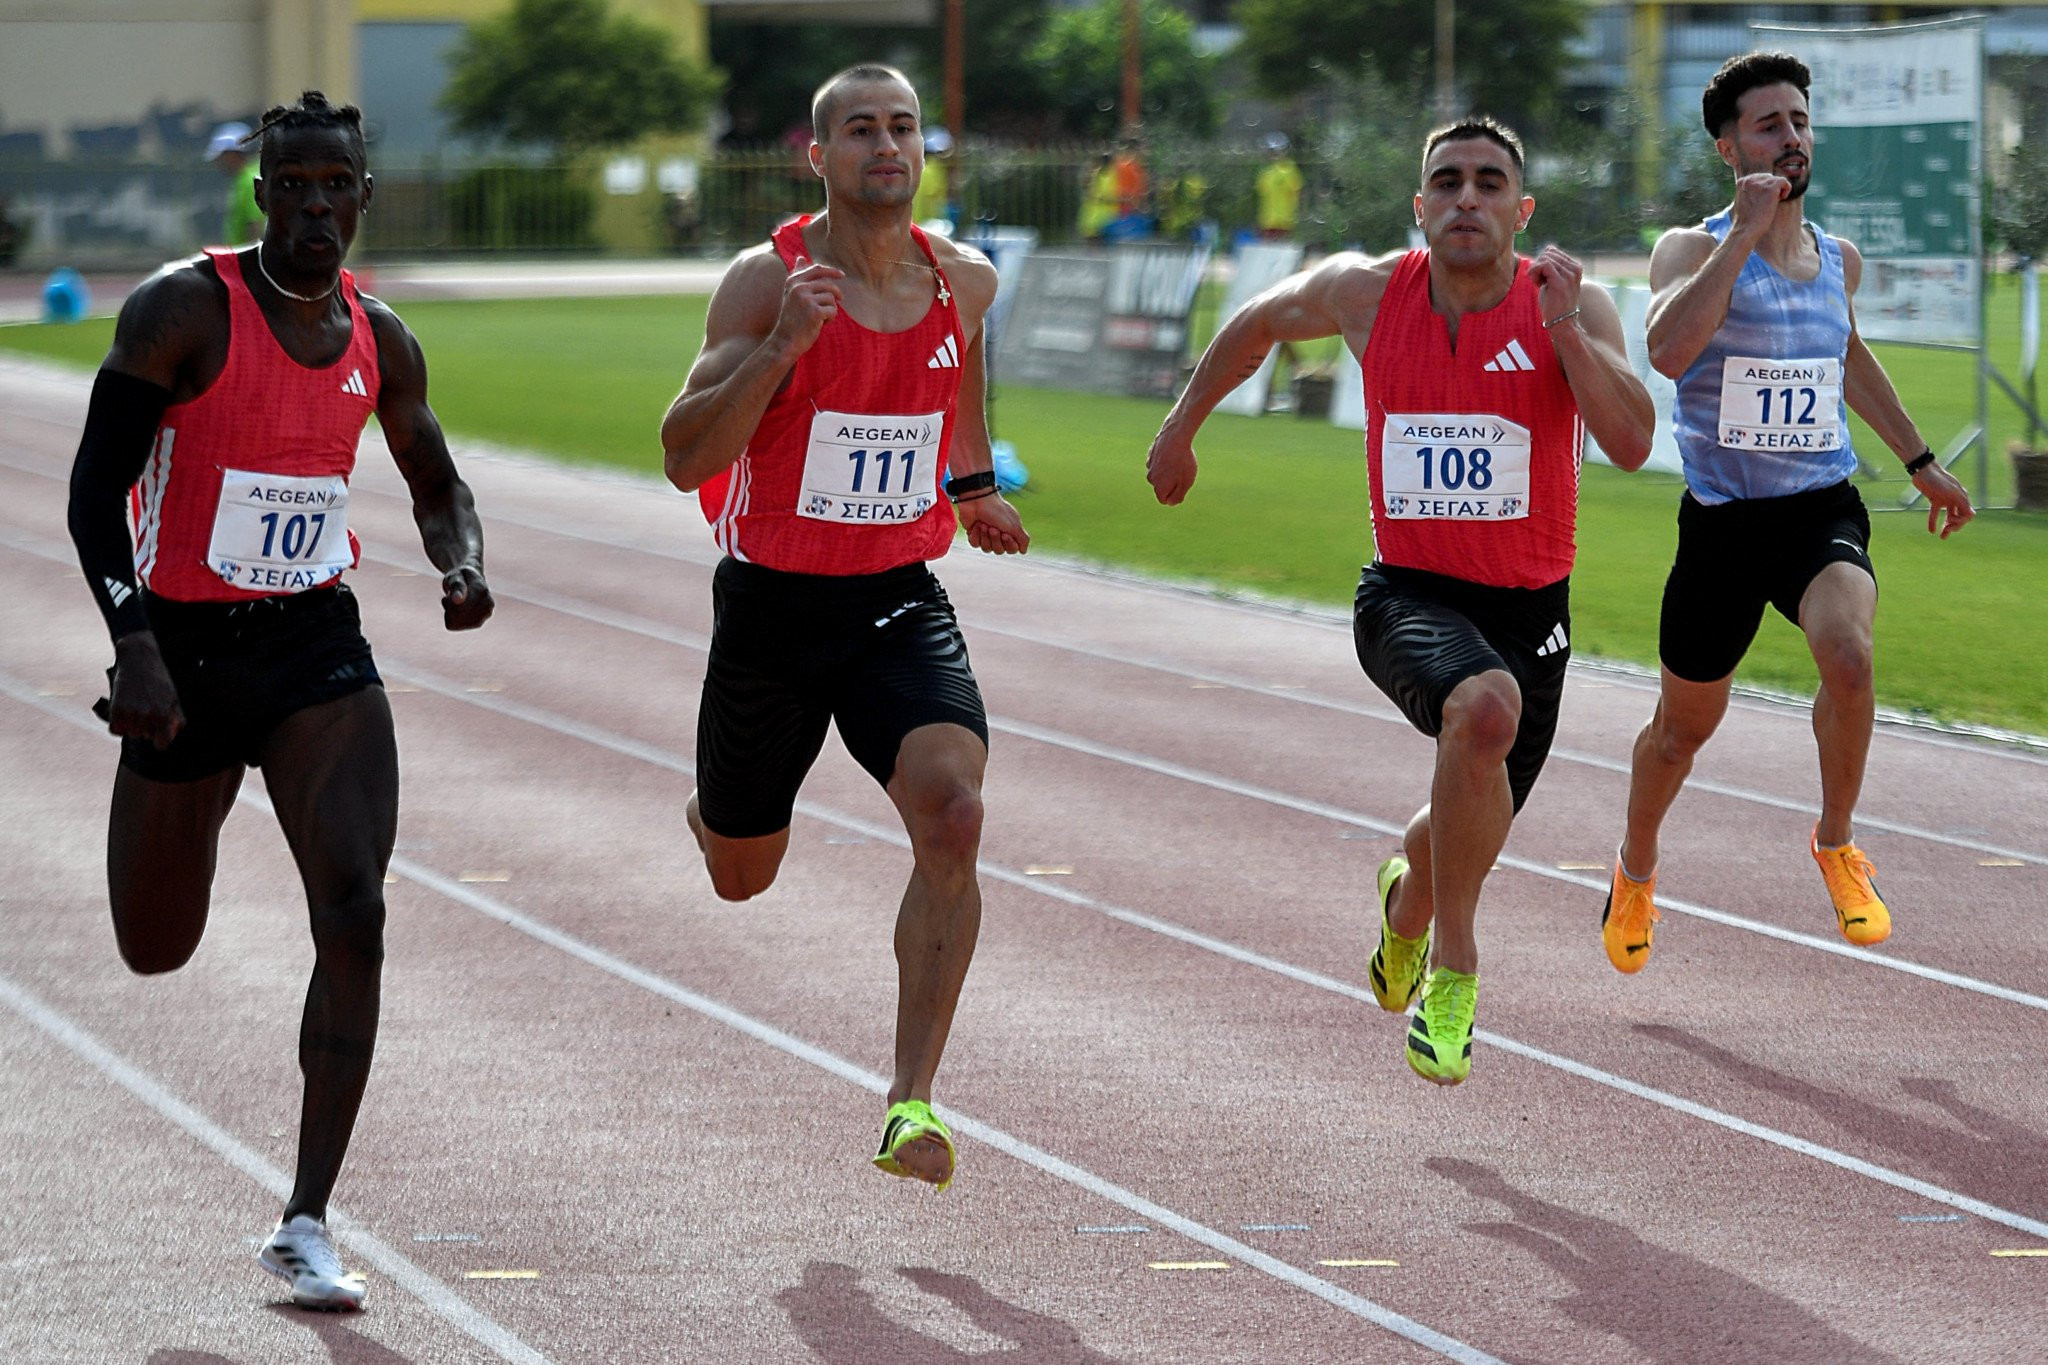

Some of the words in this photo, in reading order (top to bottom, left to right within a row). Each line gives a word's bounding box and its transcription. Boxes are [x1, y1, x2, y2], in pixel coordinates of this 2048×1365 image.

[1745, 368, 1813, 380] AEGEAN
[1756, 387, 1816, 425] 112
[836, 426, 918, 441] AEGEAN
[1403, 426, 1485, 439] AEGEAN
[1753, 433, 1813, 448] ΣΕΓΑΣ
[848, 449, 916, 493] 111
[1416, 447, 1493, 491] 108
[248, 487, 327, 505] AEGEAN
[840, 502, 908, 520] ΣΕΓΑΣ
[1417, 500, 1490, 516] ΣΕΓΑΣ
[260, 512, 326, 560] 107
[248, 568, 317, 589] ΣΕΓΑΣ
